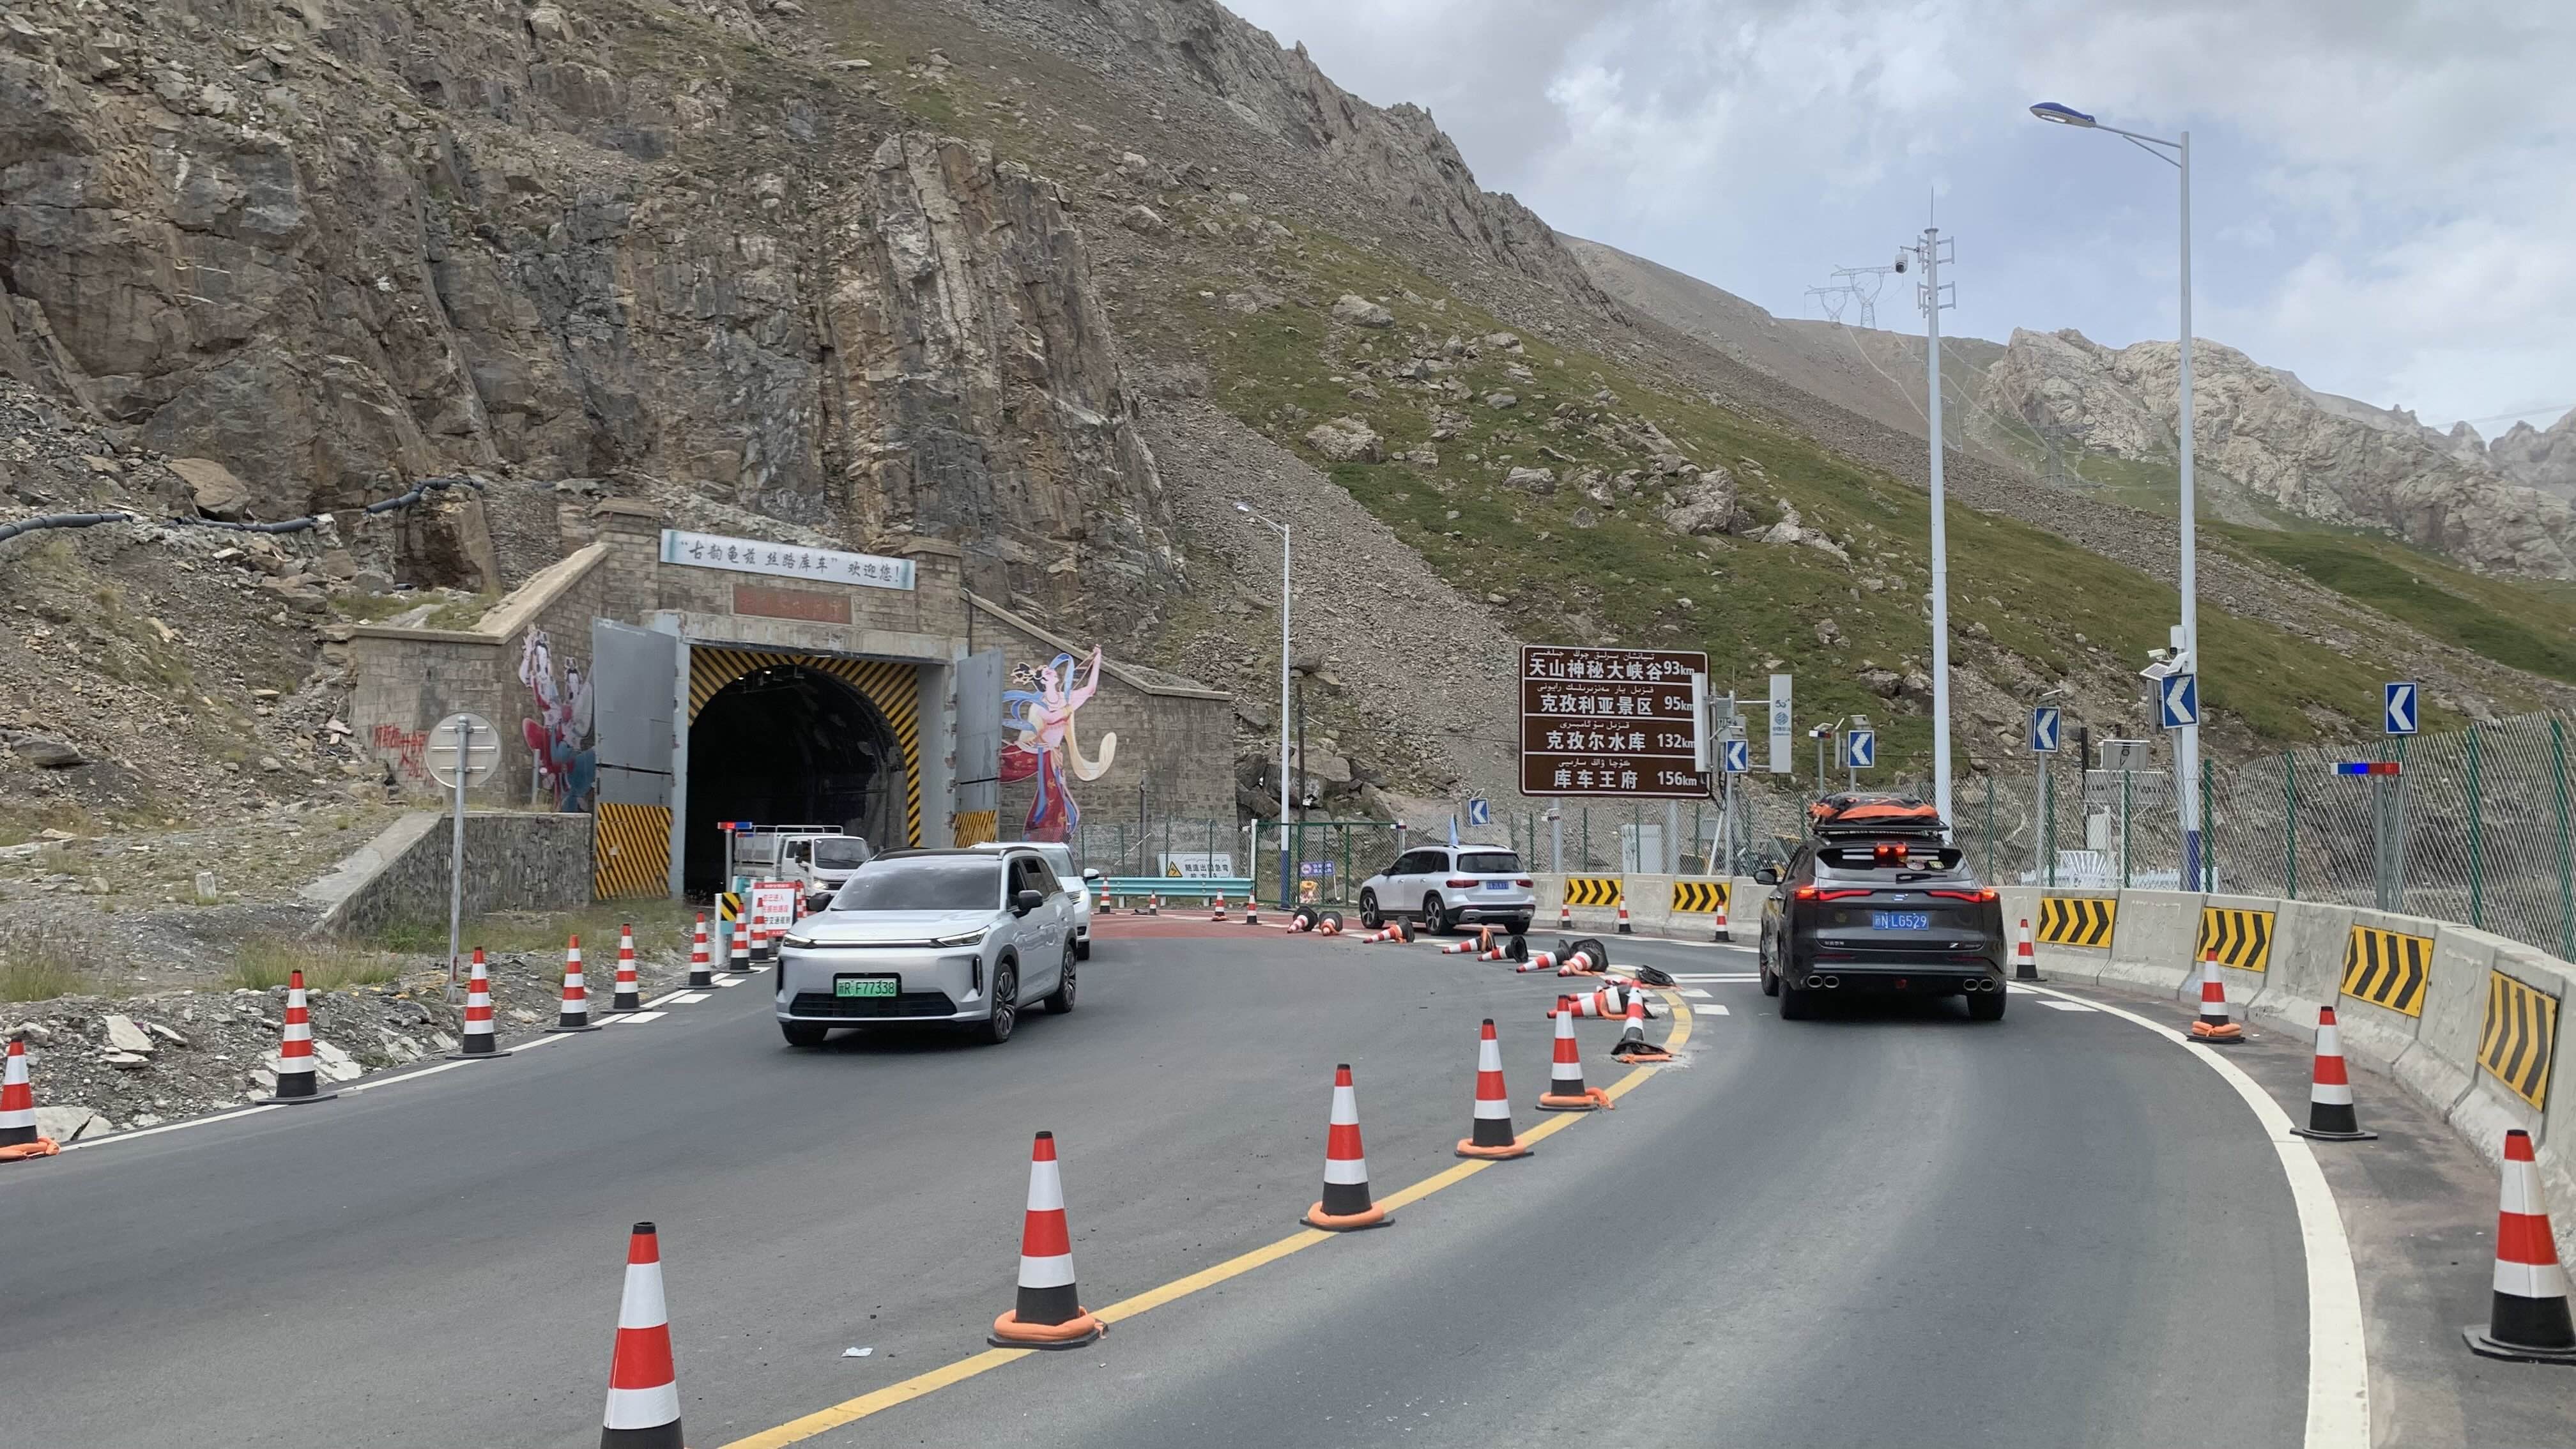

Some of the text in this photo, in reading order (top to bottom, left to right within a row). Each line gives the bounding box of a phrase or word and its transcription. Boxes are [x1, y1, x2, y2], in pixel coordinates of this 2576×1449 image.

[1529, 658, 1695, 681] 天山神秘大峡谷 93km
[1540, 693, 1653, 716] 克孜利亚景区
[1546, 730, 1646, 752] 克孜尔水库
[1553, 769, 1698, 790] 库车王府 156km
